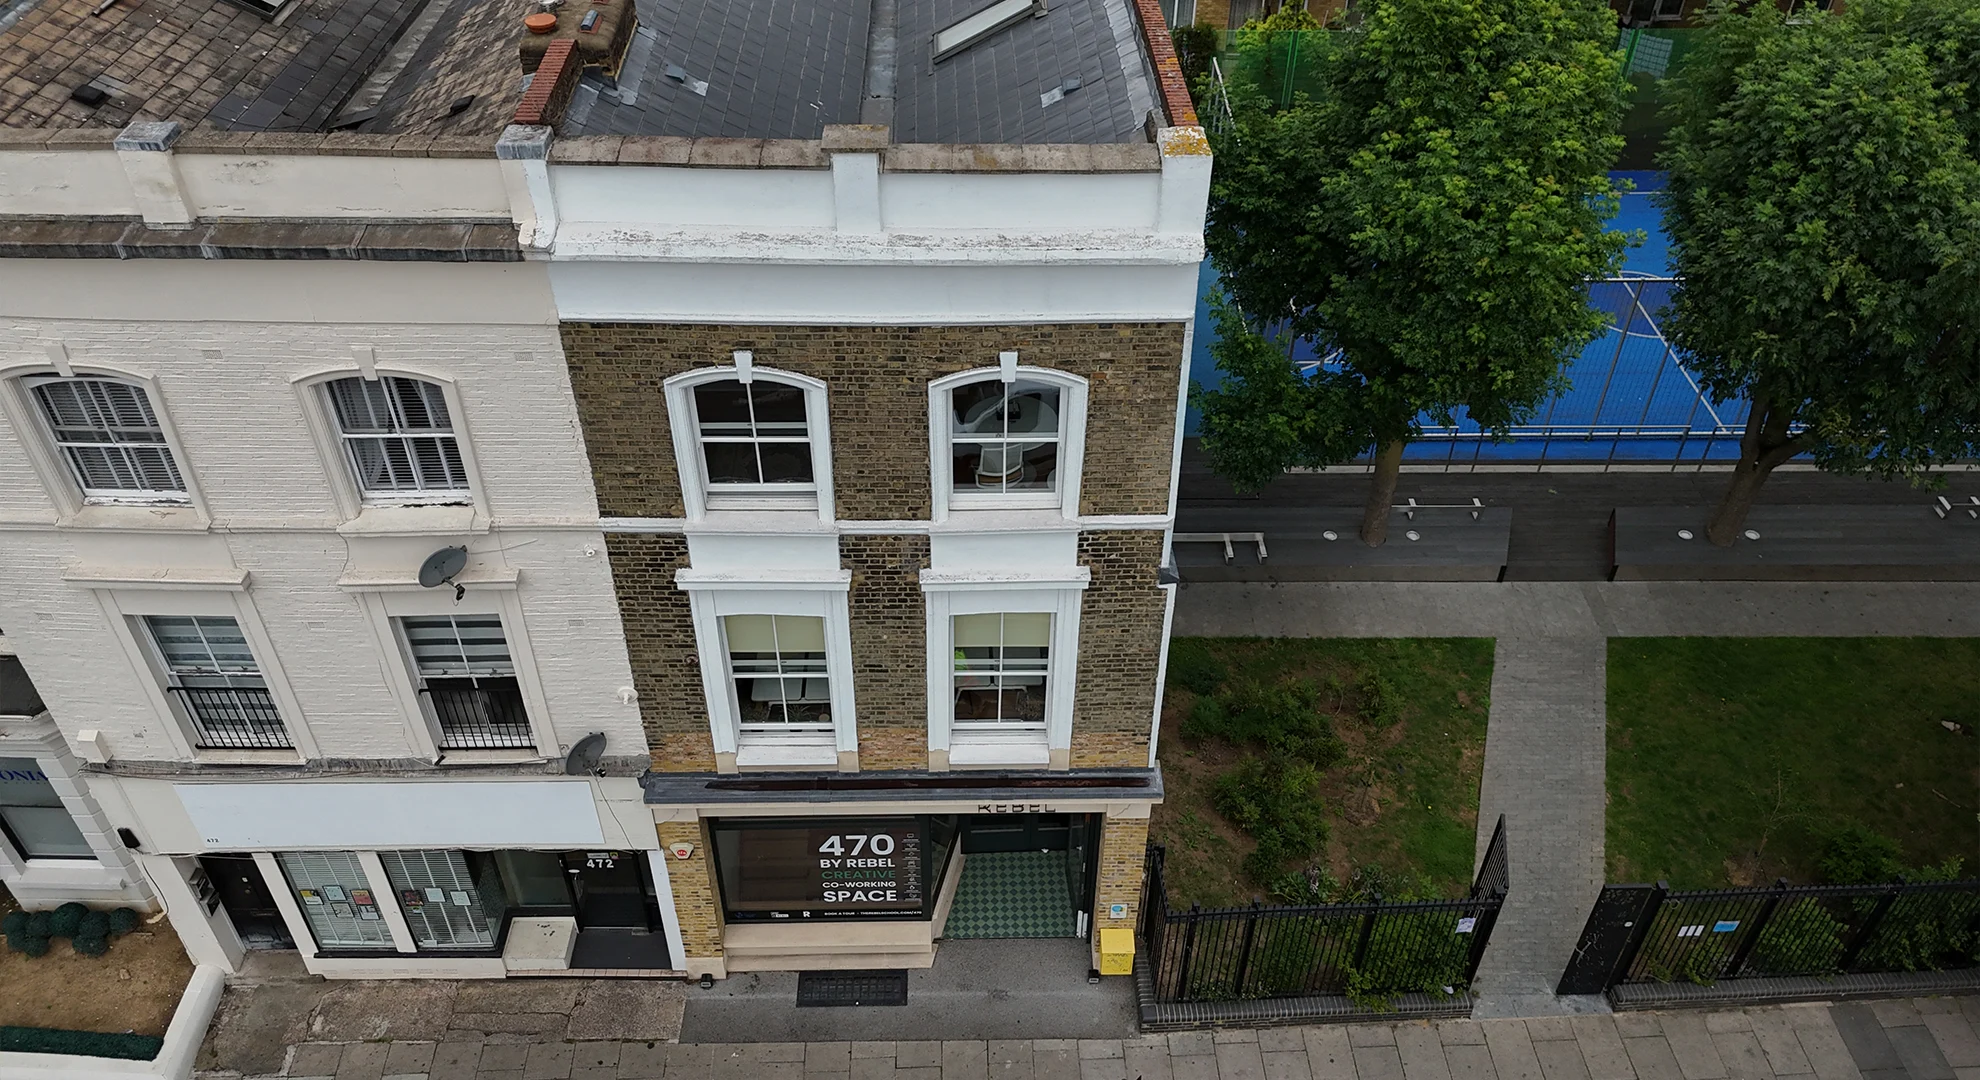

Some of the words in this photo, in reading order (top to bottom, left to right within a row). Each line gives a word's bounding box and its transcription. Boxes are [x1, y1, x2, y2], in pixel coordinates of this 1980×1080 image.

[818, 834, 895, 856] 470
[586, 859, 614, 868] 472
[820, 859, 842, 868] BY
[846, 858, 896, 868] REBEL
[821, 870, 896, 879] CREATIVE
[822, 881, 897, 889] CO-WORKING
[823, 890, 898, 903] SPACE
